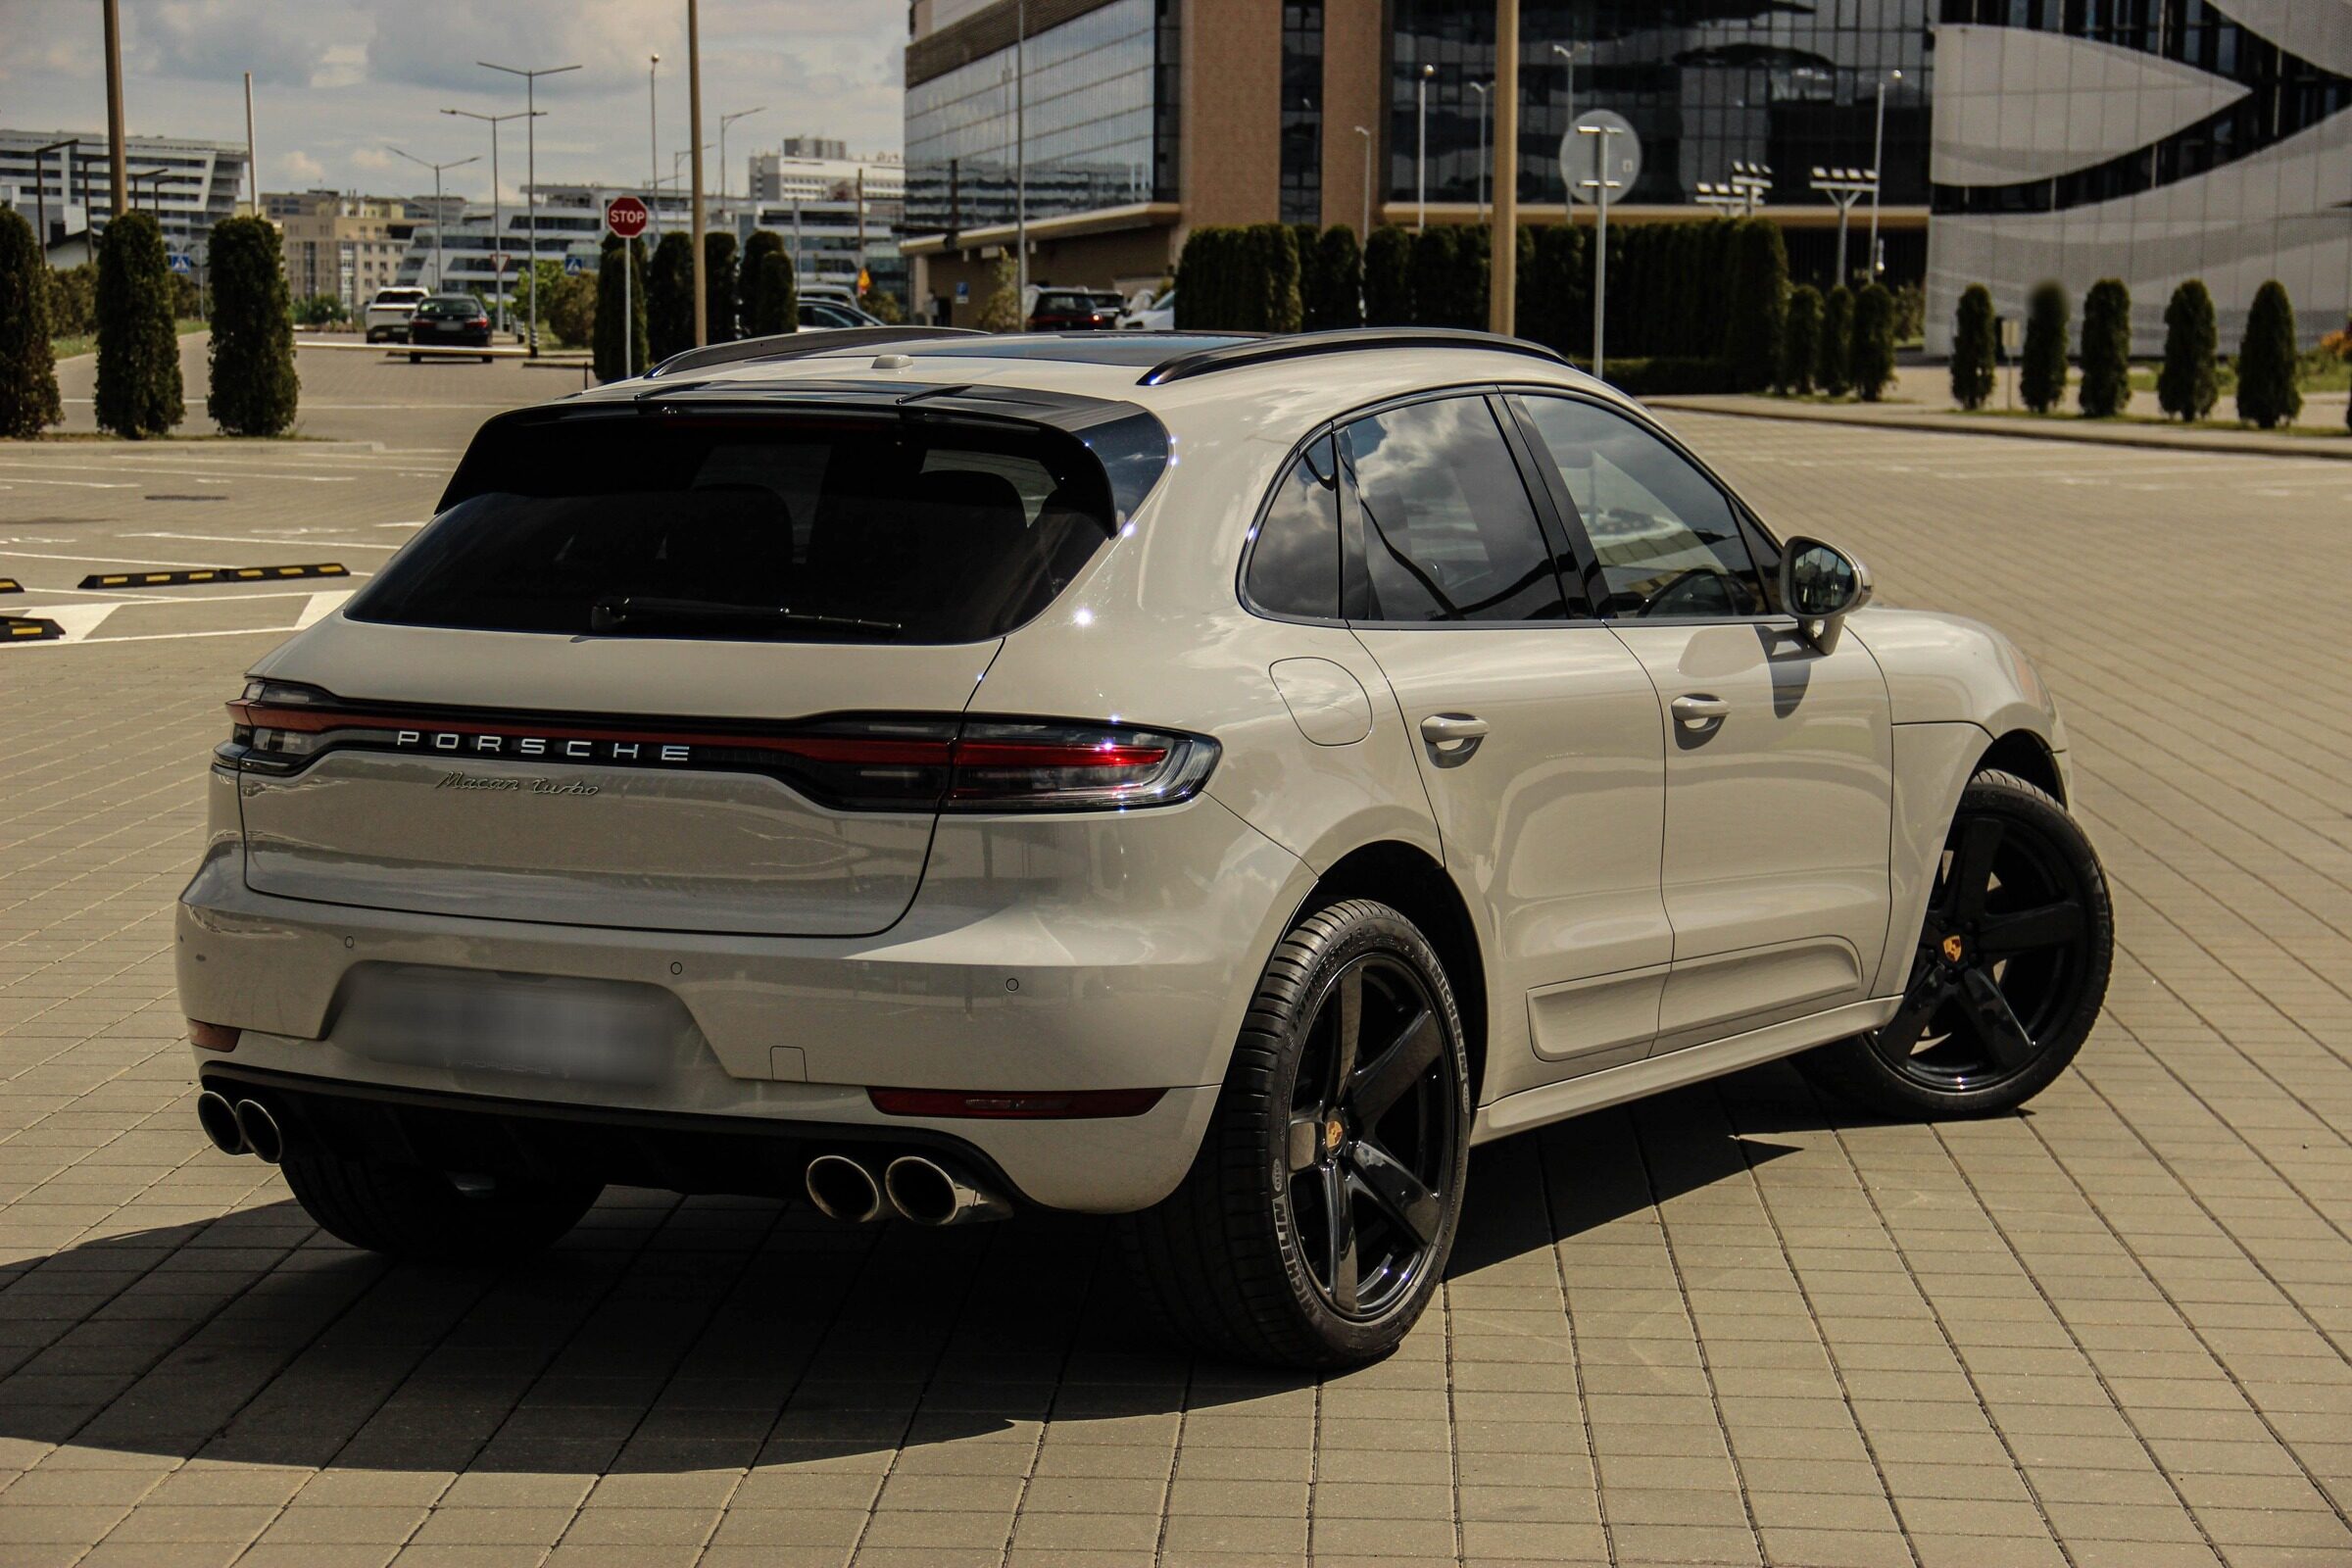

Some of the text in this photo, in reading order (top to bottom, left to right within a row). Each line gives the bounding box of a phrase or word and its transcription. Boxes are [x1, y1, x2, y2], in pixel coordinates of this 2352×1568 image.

[611, 210, 645, 223] STOP
[397, 731, 690, 761] PORSCHE
[435, 771, 518, 790] Macan
[1431, 961, 1468, 1075] MICHELIN
[1273, 1201, 1319, 1319] MICHELIN
